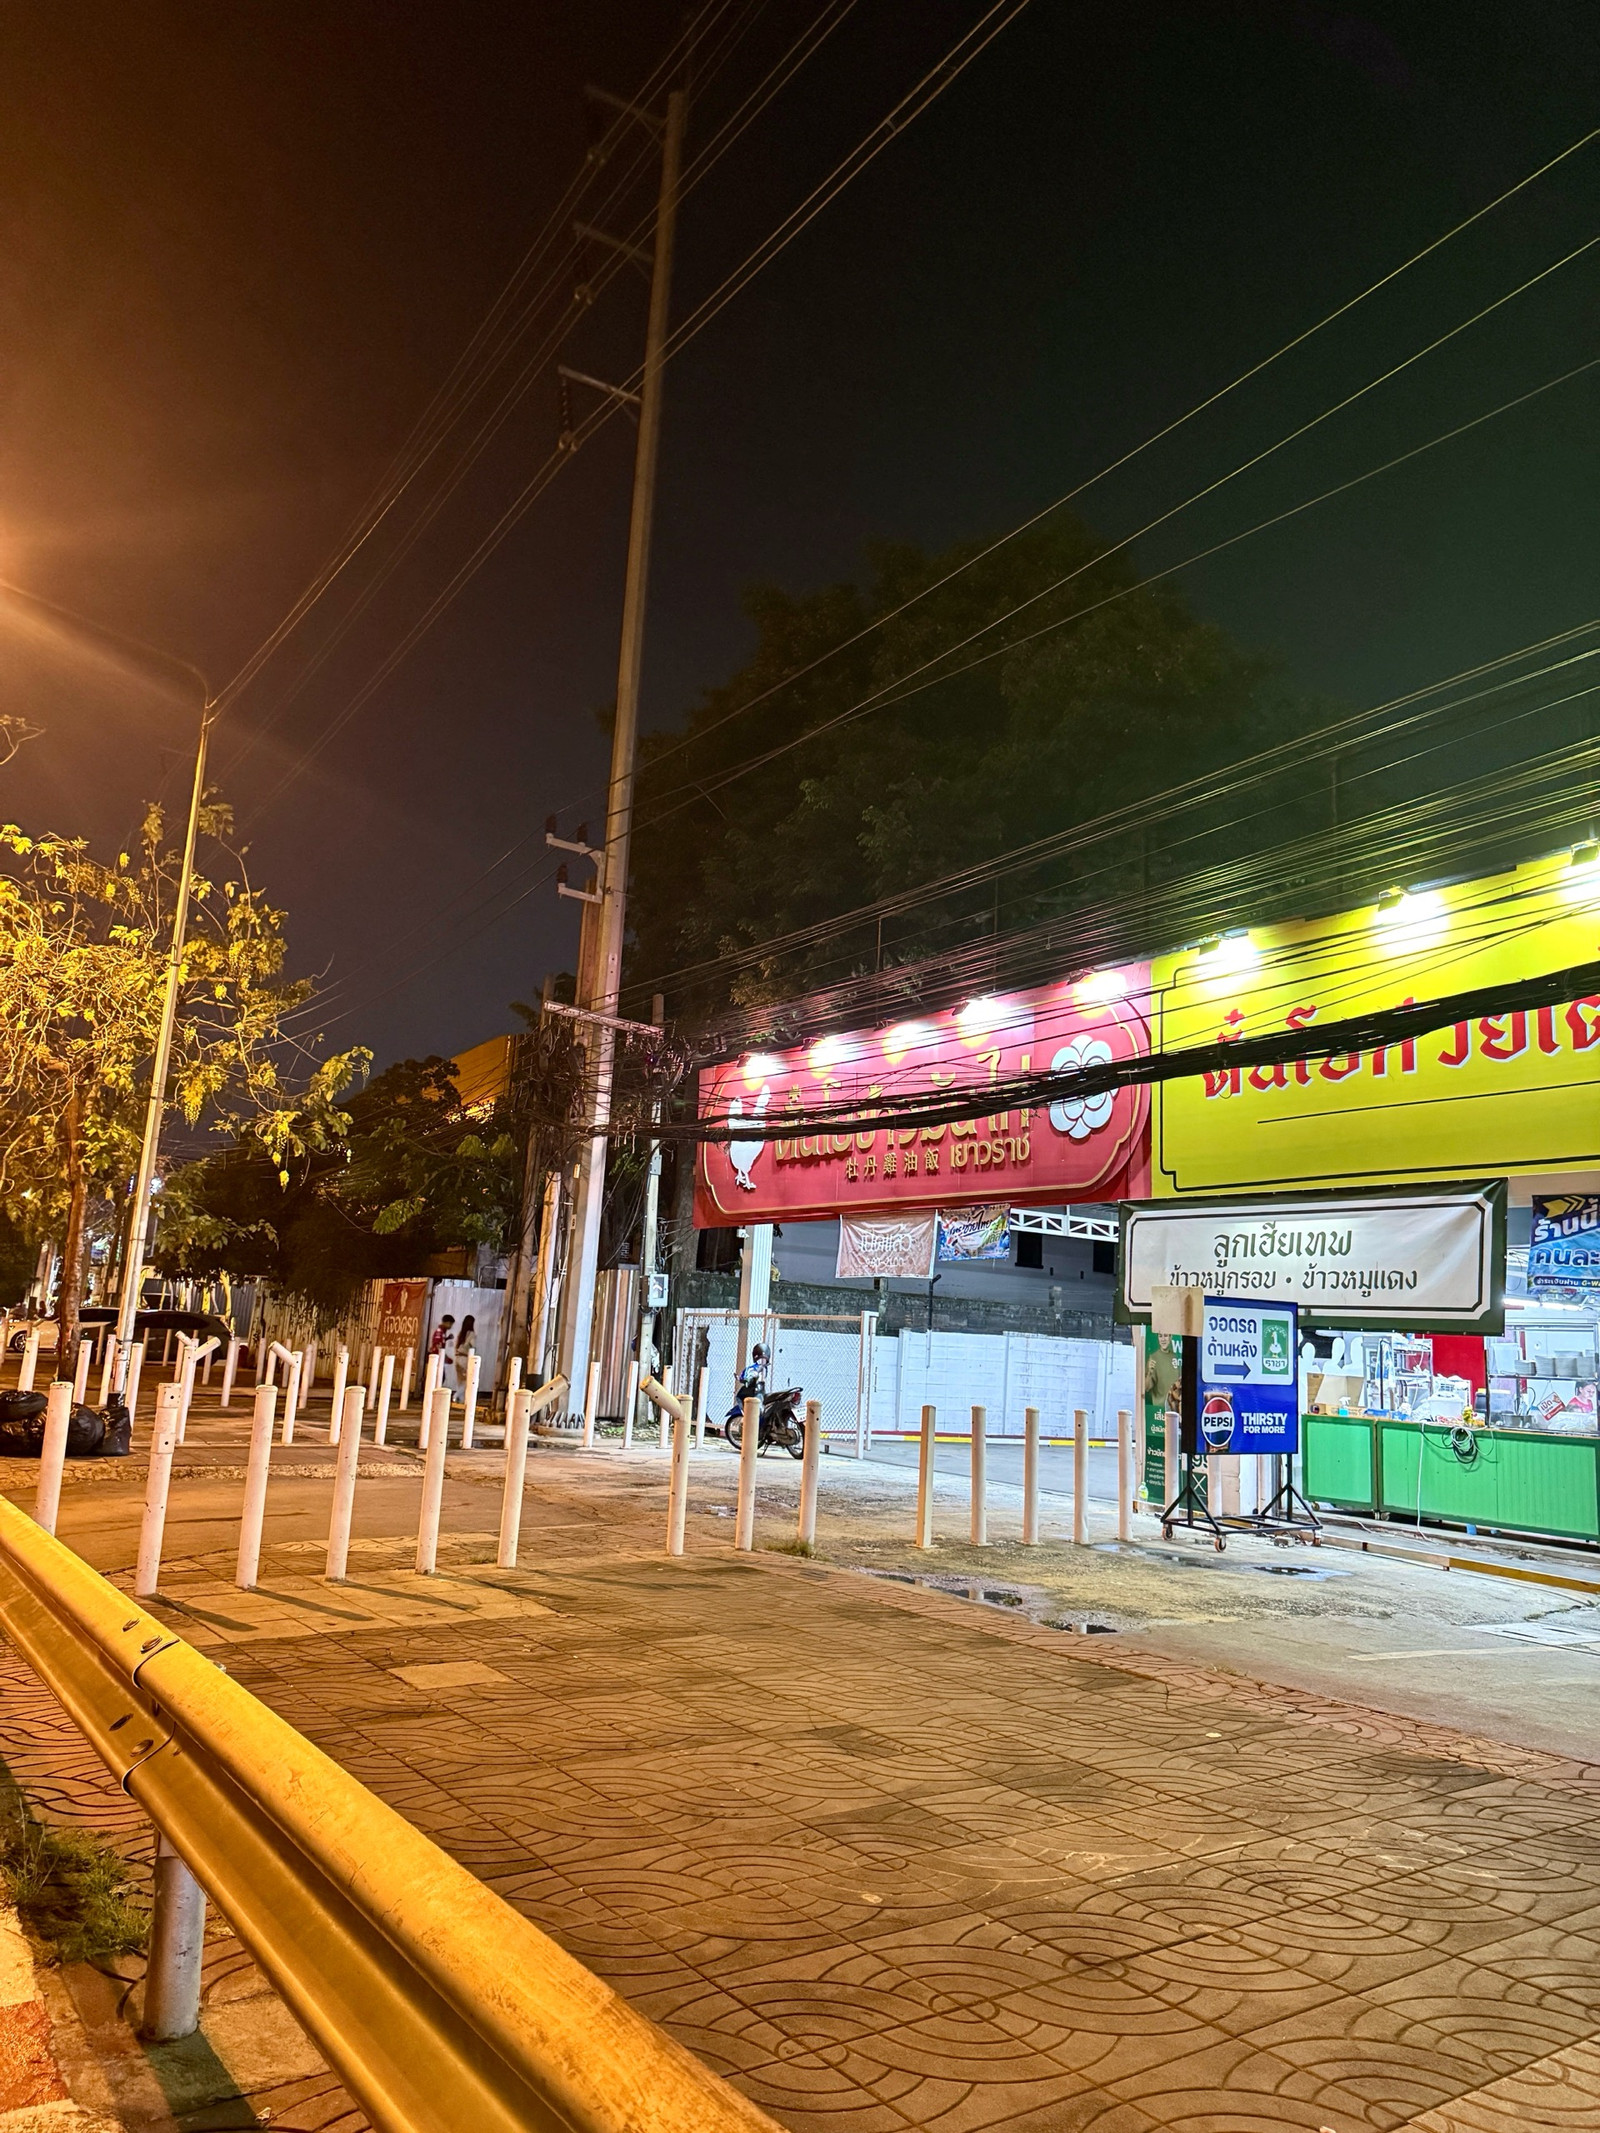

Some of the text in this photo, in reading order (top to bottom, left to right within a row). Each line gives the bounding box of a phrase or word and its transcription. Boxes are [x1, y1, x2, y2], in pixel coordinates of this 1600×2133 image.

[950, 1132, 1030, 1168] เยาวราช
[845, 1150, 940, 1179] 牡丹雞油飯
[1534, 1197, 1599, 1242] ร้านนี้
[1214, 1221, 1352, 1268] ลูกเฮียเทพ
[1535, 1247, 1600, 1267] คนละ
[1169, 1263, 1418, 1297] ข้าวหมูกรอบ ข้าวหมูแดง
[1208, 1316, 1257, 1334] จอดรถ
[1207, 1336, 1258, 1358] ด้านหลัง
[1203, 1413, 1288, 1427] PEPSI THIRSTY
[1243, 1426, 1286, 1434] FOR MORE
